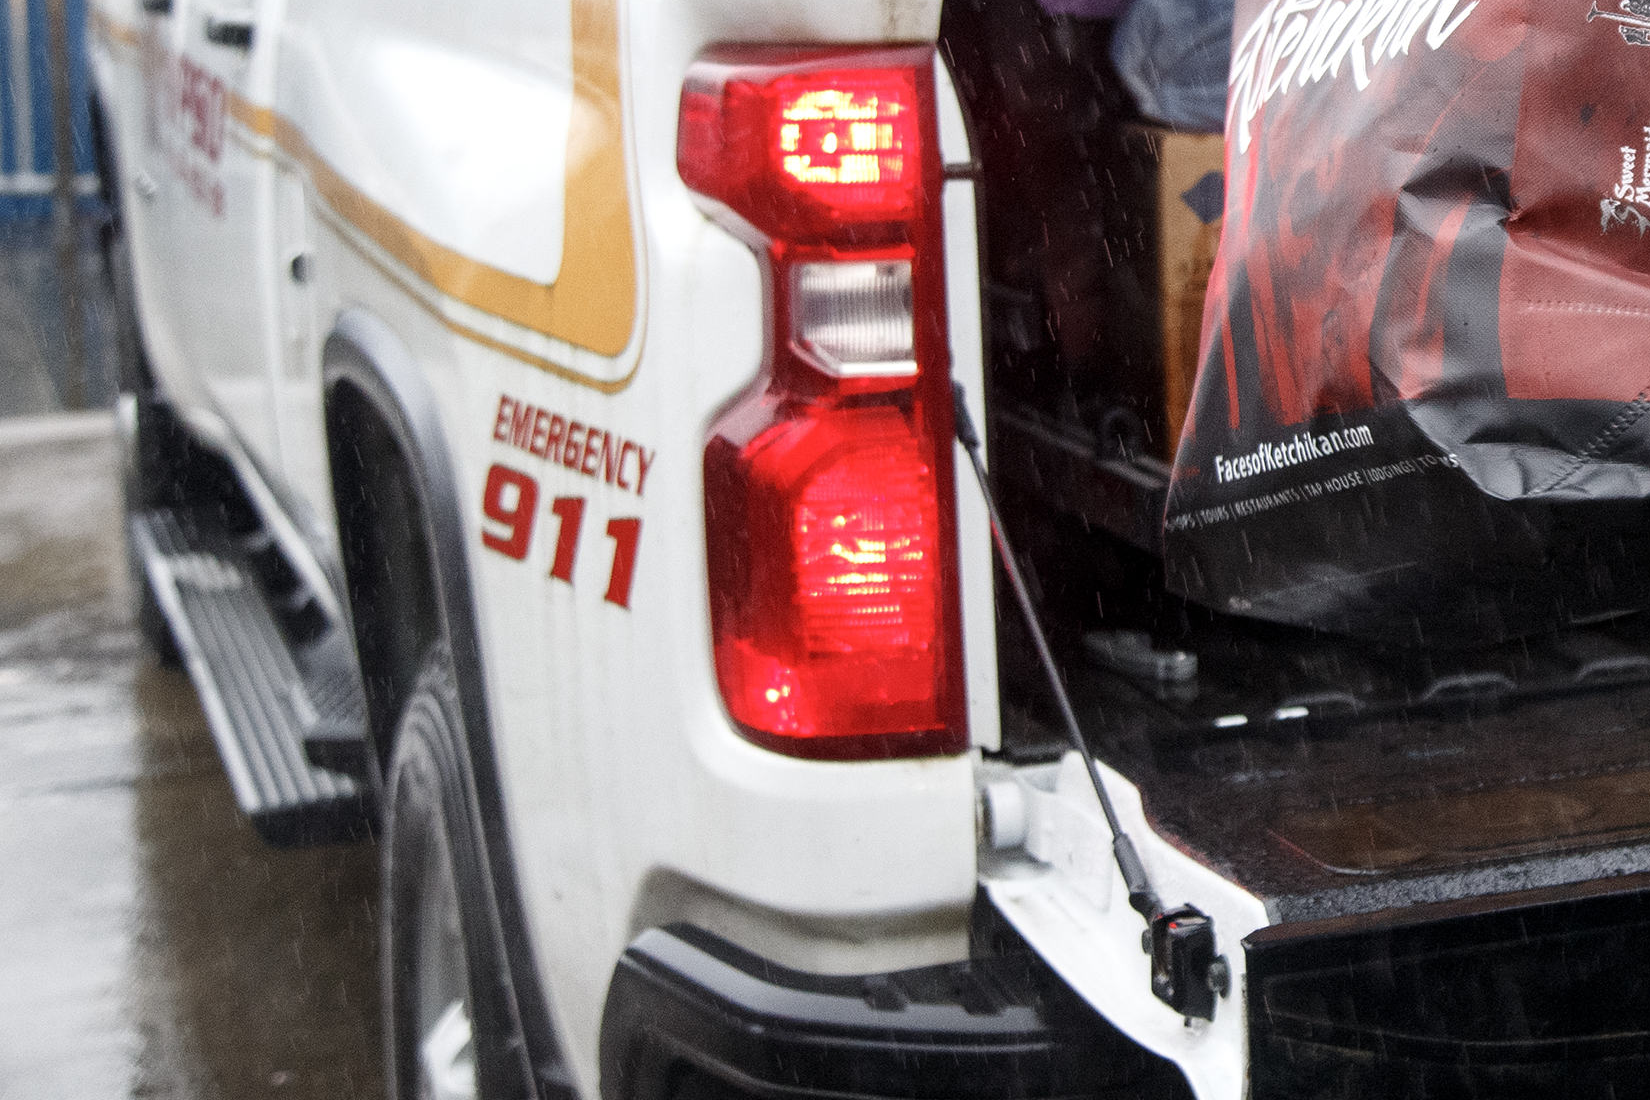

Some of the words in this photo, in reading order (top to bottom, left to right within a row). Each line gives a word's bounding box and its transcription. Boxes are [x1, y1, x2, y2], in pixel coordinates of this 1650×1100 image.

[1614, 146, 1637, 202] Sweet
[493, 394, 656, 496] EMERGENCY
[1215, 424, 1374, 483] FacesofKetchikan.com
[1200, 506, 1230, 526] TOURS
[1235, 487, 1300, 517] RESTAURANTS
[1305, 484, 1323, 500] TAP
[1325, 470, 1363, 492] HOUSE
[1368, 460, 1414, 483] LODGINGS
[481, 463, 643, 610] 911
